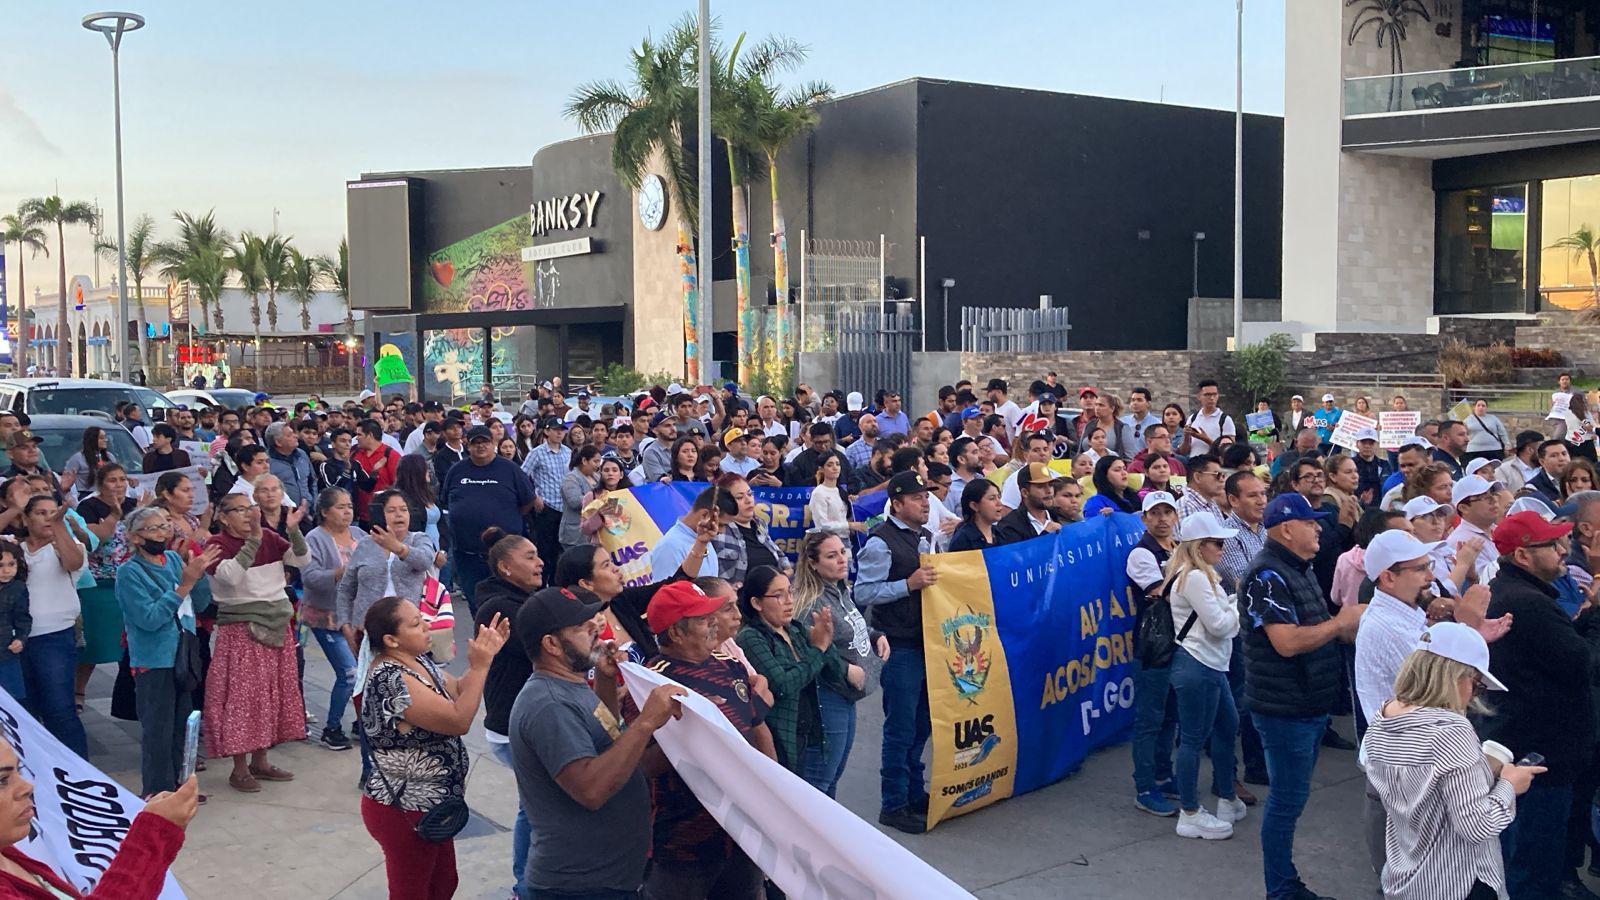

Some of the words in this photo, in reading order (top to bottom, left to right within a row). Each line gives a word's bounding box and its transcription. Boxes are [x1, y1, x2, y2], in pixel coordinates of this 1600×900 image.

[530, 189, 600, 236] BANKSY
[460, 478, 499, 486] Champion
[610, 541, 649, 567] UAS
[954, 713, 995, 750] UAS
[942, 779, 975, 797] SOMOS
[974, 766, 1009, 787] GRANDES
